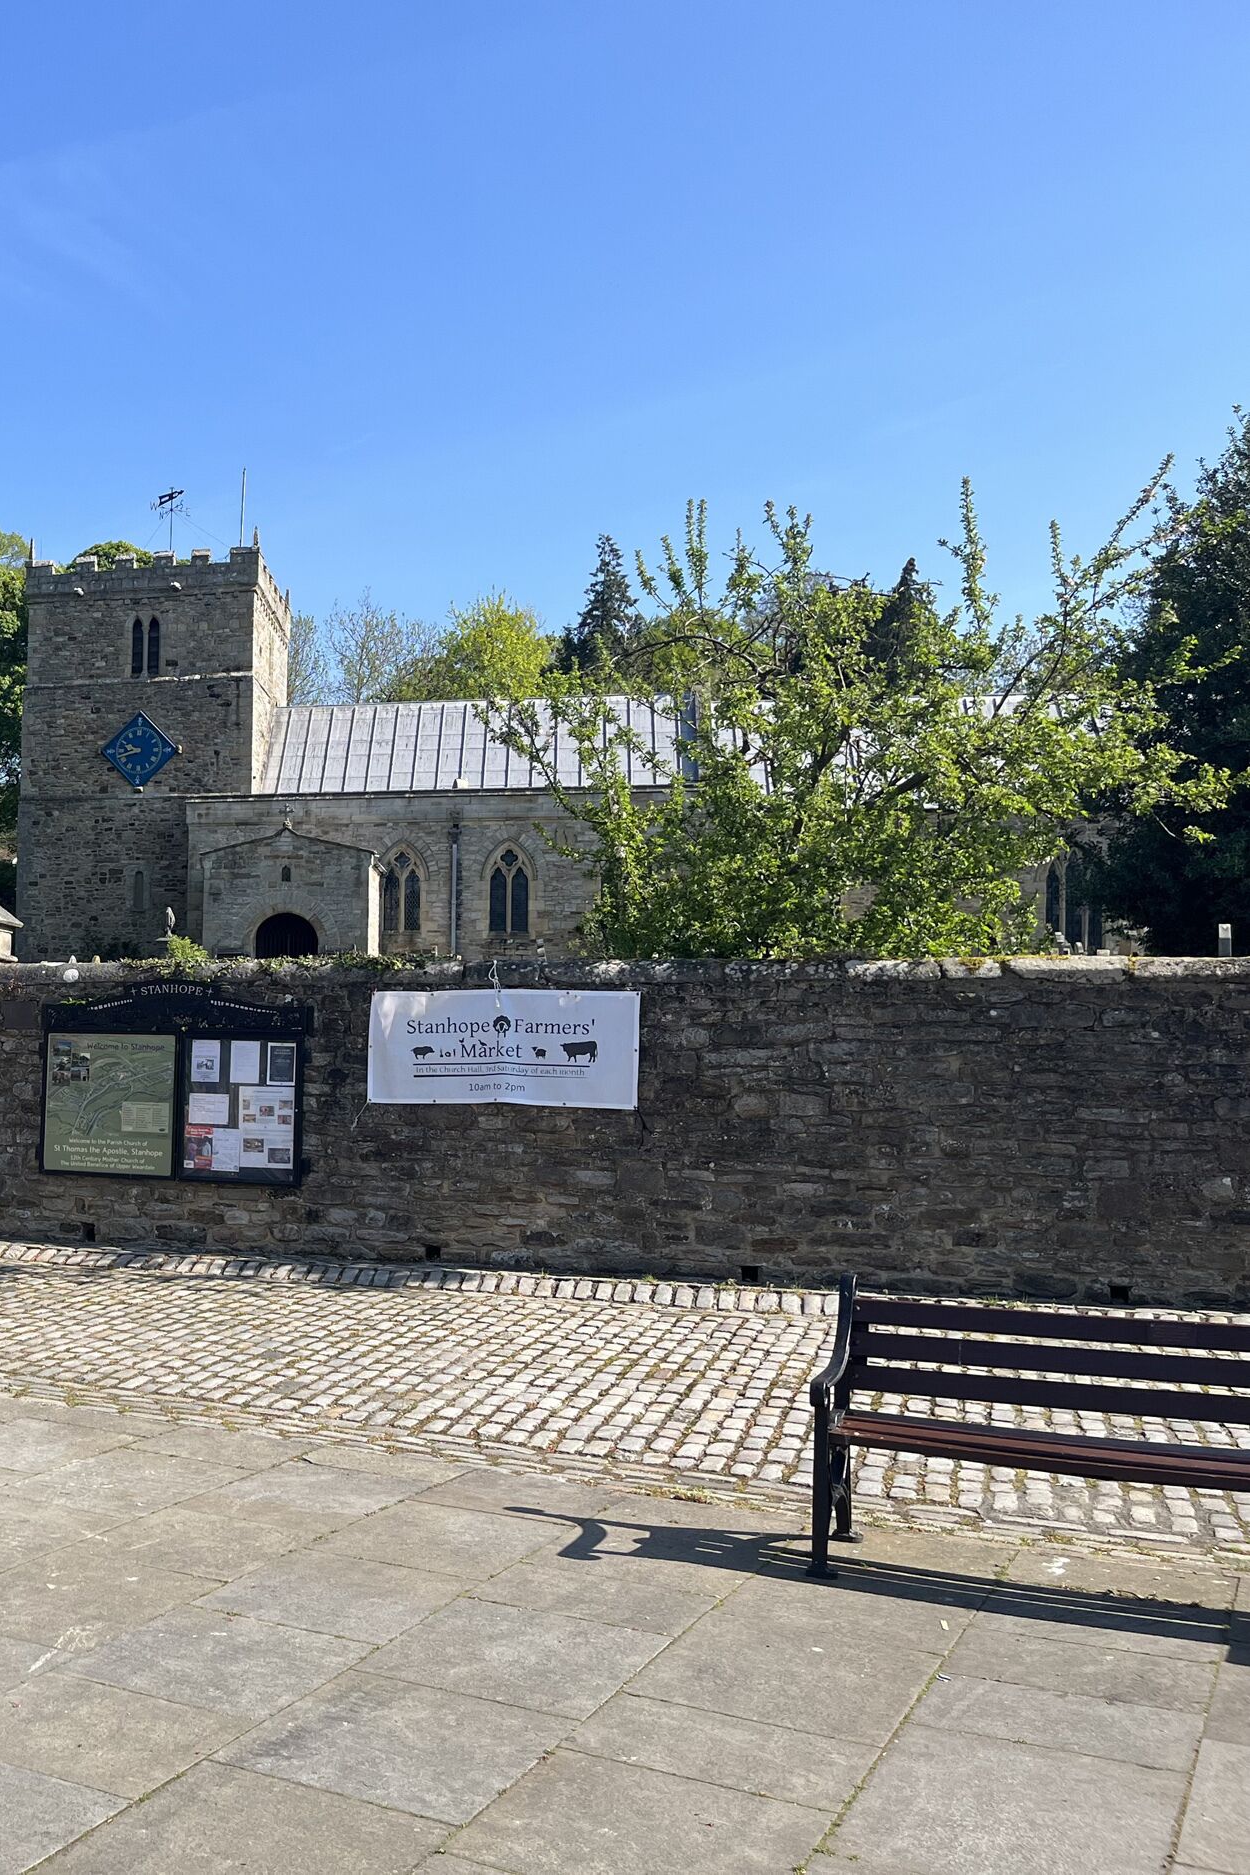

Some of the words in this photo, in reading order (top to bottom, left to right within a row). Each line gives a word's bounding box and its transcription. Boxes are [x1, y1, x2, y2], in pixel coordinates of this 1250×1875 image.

[140, 984, 204, 996] STANHOPE
[406, 1017, 490, 1038] Stanhope
[514, 1018, 595, 1035] Farmers'
[87, 1042, 119, 1050] Welcome
[131, 1043, 165, 1052] Stanhope
[460, 1040, 523, 1058] Market
[497, 1066, 528, 1076] Saturday
[530, 1066, 538, 1074] of
[540, 1067, 558, 1075] each
[559, 1068, 585, 1076] month
[469, 1083, 491, 1092] 10am
[493, 1082, 502, 1091] to
[504, 1083, 525, 1093] 2pm
[54, 1144, 61, 1152] St
[62, 1145, 88, 1153] Thomas
[90, 1145, 101, 1154] the
[131, 1148, 163, 1158] Stanhope
